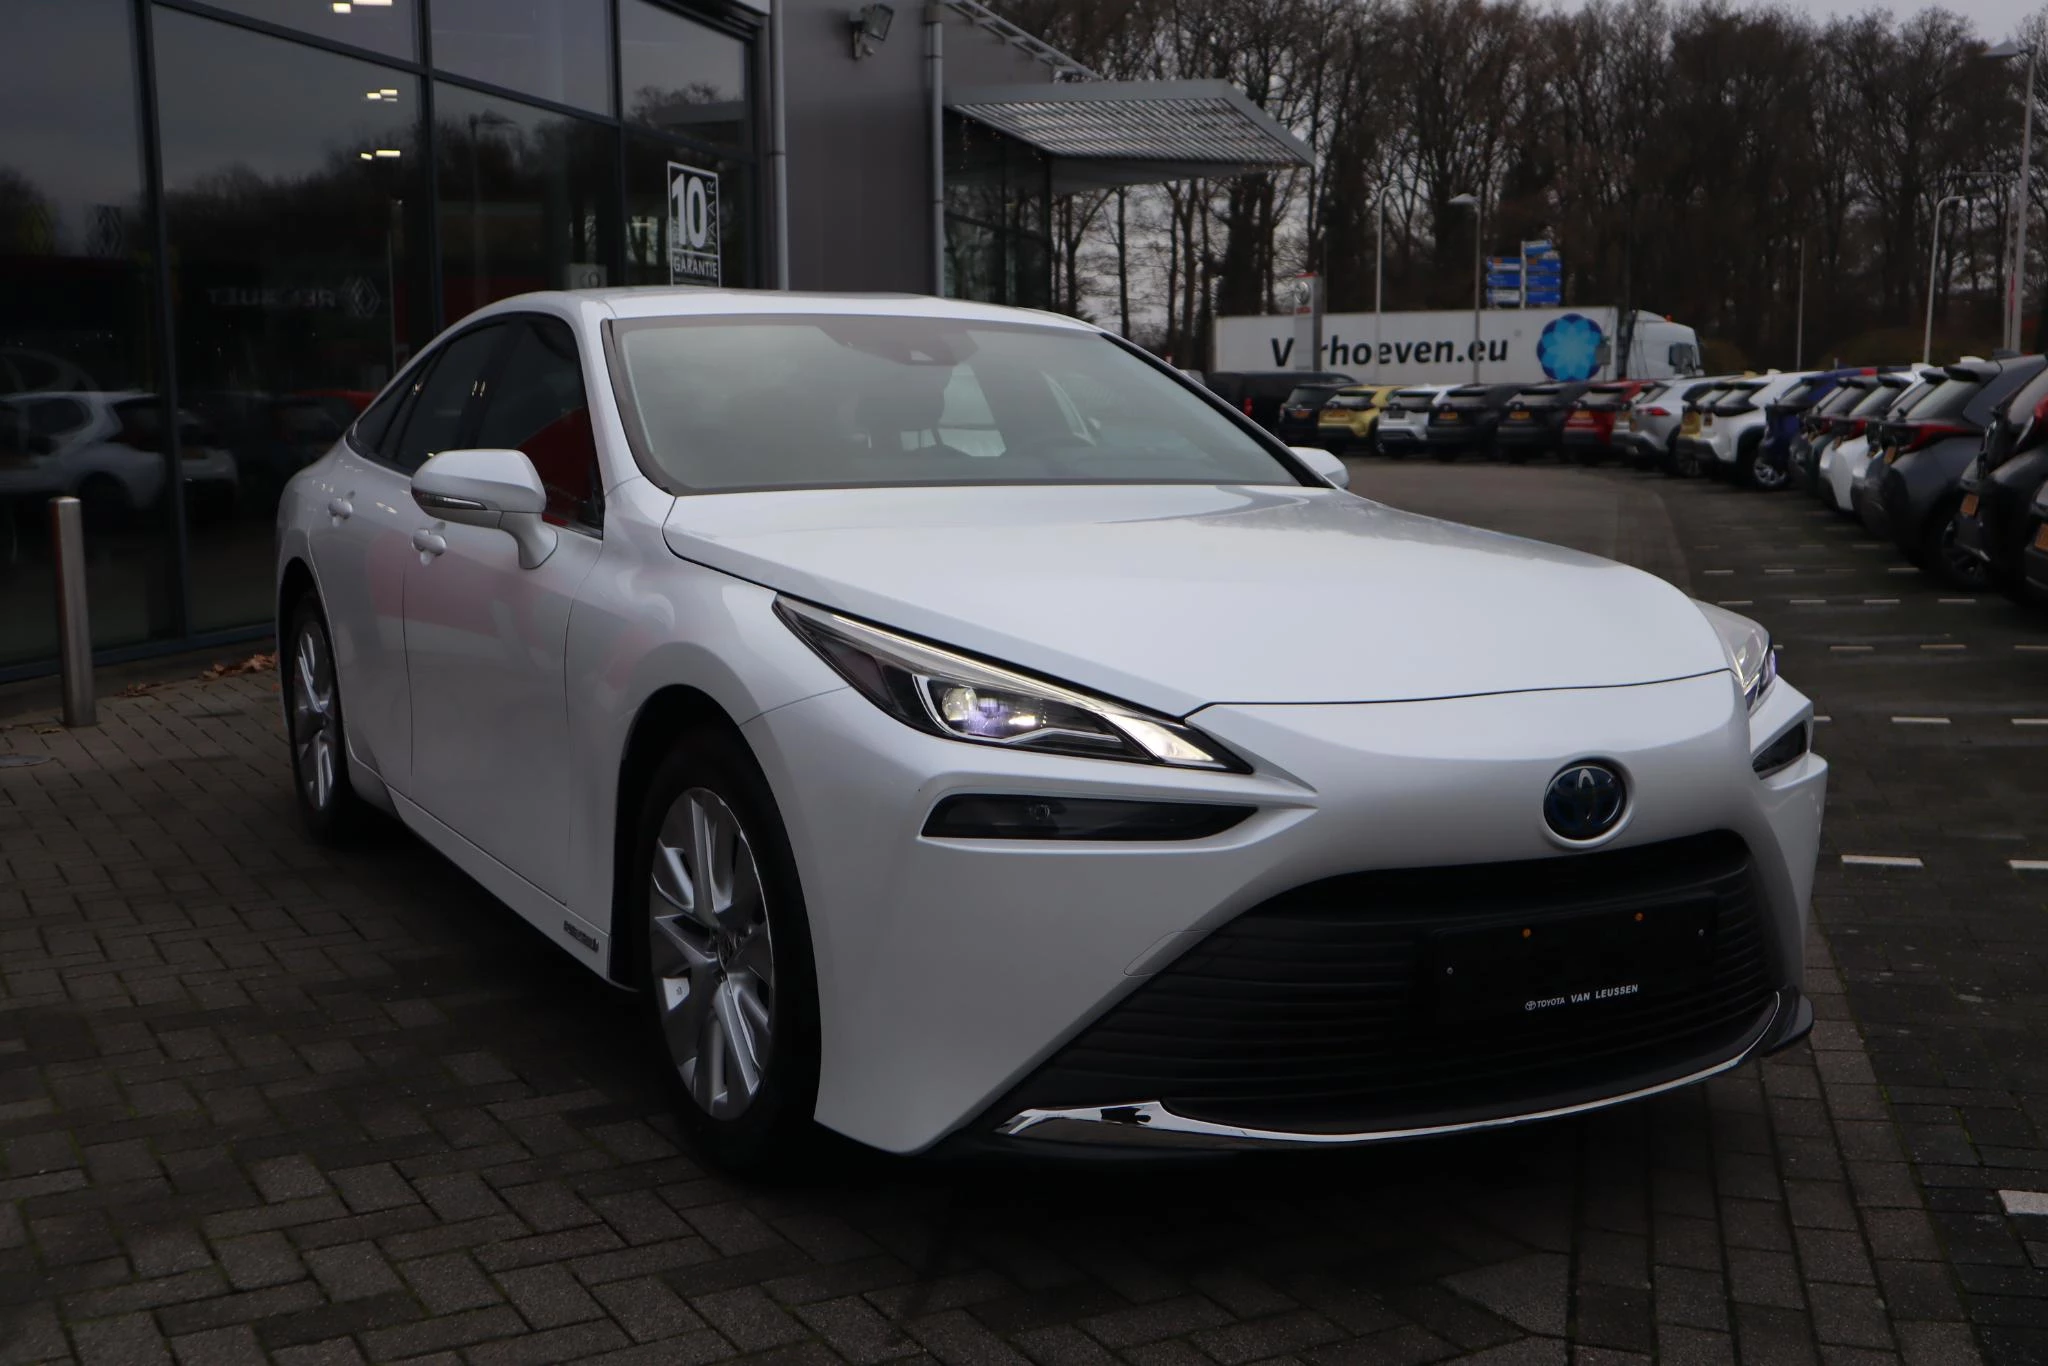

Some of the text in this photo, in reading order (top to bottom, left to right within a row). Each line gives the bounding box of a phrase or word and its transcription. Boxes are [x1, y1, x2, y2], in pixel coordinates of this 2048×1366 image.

[671, 173, 707, 248] 10
[706, 181, 717, 254] JAAR
[673, 257, 718, 277] GARANTIE
[1271, 335, 1508, 367] Vhoeven.eu
[1536, 984, 1638, 1008] TOYOTA VAN LEUSSEN
